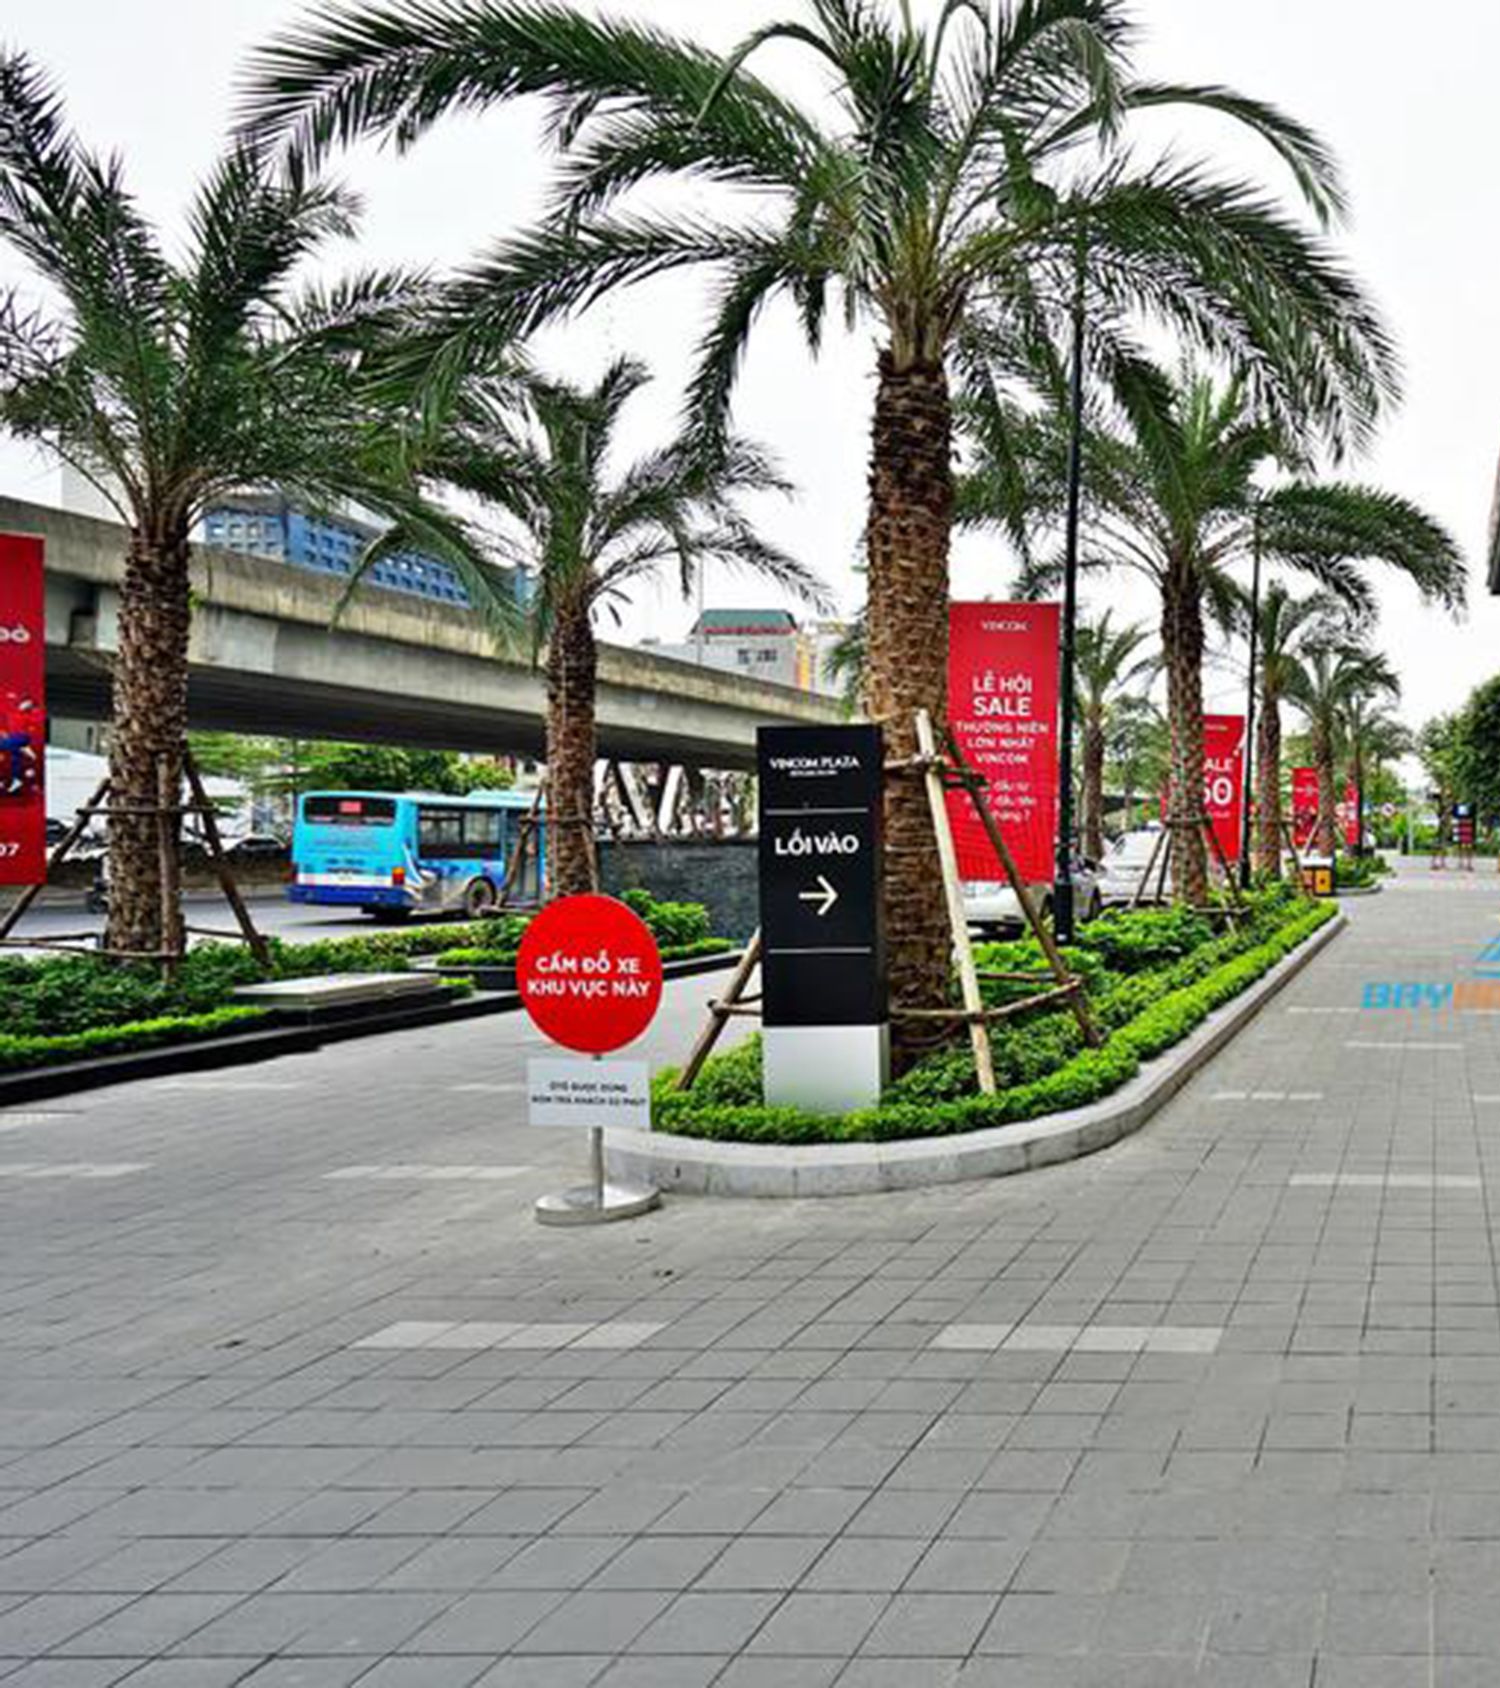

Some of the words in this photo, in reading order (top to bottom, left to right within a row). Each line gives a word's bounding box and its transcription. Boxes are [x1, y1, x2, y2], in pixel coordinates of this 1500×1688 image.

[972, 696, 1032, 716] SALE
[769, 757, 818, 769] VINCOM
[820, 755, 861, 768] PLAZA
[775, 828, 813, 855] LỐI
[814, 831, 860, 854] VÀO
[535, 950, 578, 974] CẤM
[617, 957, 641, 974] XE
[527, 979, 567, 996] KHU
[568, 979, 608, 999] VỰC
[612, 977, 651, 997] NÀY
